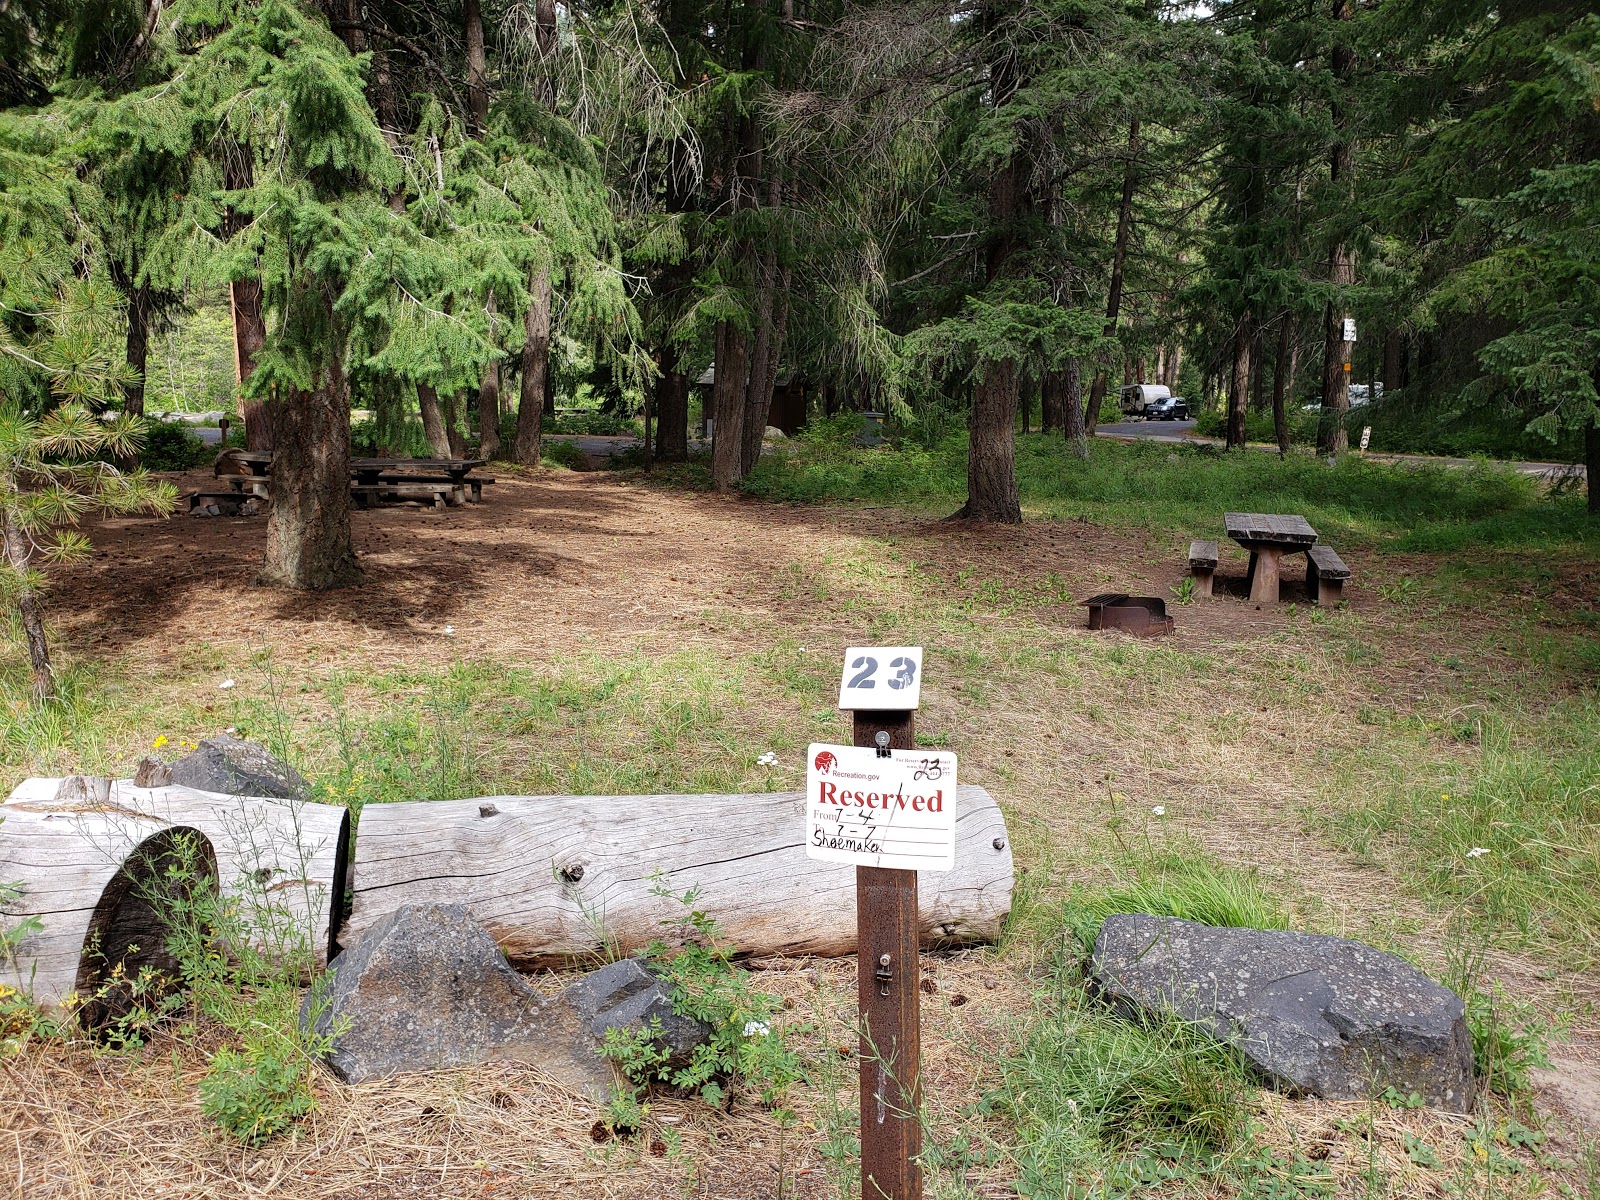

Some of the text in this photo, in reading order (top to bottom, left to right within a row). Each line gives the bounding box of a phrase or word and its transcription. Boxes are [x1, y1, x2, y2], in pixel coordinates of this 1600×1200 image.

[847, 656, 916, 690] 23
[832, 770, 880, 781] Recreation.gov
[914, 758, 942, 780] 23
[818, 781, 944, 813] Reserved
[813, 809, 837, 821] From
